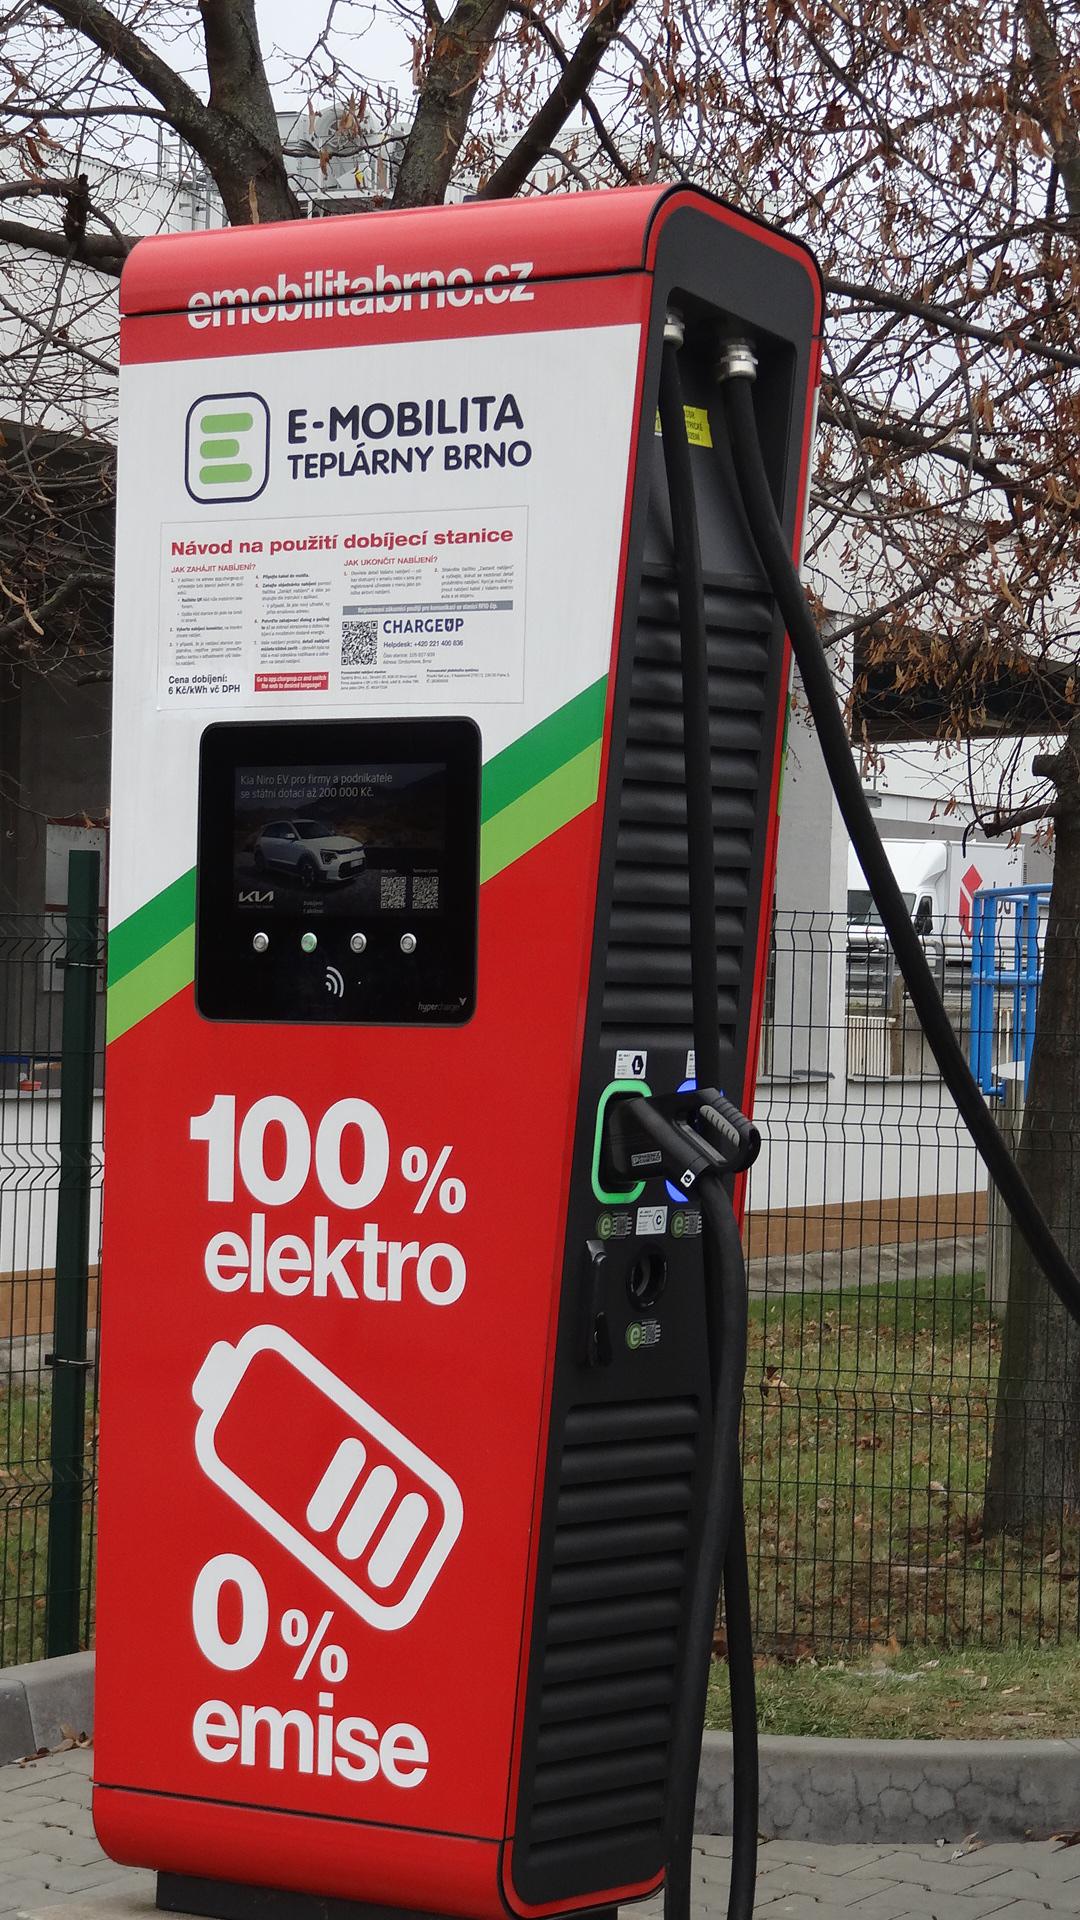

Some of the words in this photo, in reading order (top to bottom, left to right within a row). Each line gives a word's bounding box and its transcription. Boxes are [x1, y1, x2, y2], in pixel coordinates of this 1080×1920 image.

[187, 262, 534, 329] emobilitabrno.cz
[288, 393, 524, 445] E-MOBILITA
[287, 442, 434, 480] TEPLÁRNY
[444, 440, 532, 472] BRNO
[171, 539, 233, 556] Návod
[239, 541, 263, 553] na
[270, 534, 339, 555] použití
[344, 531, 429, 550] dobíjecí
[434, 528, 513, 545] stanice
[187, 564, 217, 573] ZAHÁJIT
[218, 563, 256, 572] NABÍJENÍ?
[361, 557, 395, 566] UKONČIT
[397, 555, 438, 565] NABÍJENÍ?
[383, 618, 464, 634] CHARGEUP
[383, 641, 412, 649] Helpdesk:
[168, 675, 189, 684] Cena
[192, 674, 228, 685] dobíjení:
[168, 686, 174, 695] 6
[175, 685, 208, 695] Kč/kWh
[210, 685, 220, 693] vč
[222, 684, 241, 693] DPH
[240, 775, 254, 785] Kia
[256, 775, 275, 785] Niro
[277, 774, 289, 784] EV
[291, 776, 306, 787] pro
[307, 774, 331, 787] firmy
[332, 775, 339, 784] a
[341, 773, 393, 786] podnikatele
[240, 790, 250, 799] se
[306, 787, 317, 798] až
[319, 787, 337, 798] 200
[339, 787, 358, 797] 000
[634, 1059, 641, 1071] L
[190, 1094, 390, 1210] 100
[400, 1145, 467, 1214] %
[656, 1215, 662, 1224] C
[204, 1213, 467, 1306] elektro
[192, 1553, 269, 1671] 0
[280, 1609, 348, 1683] %
[192, 1691, 429, 1788] emise
